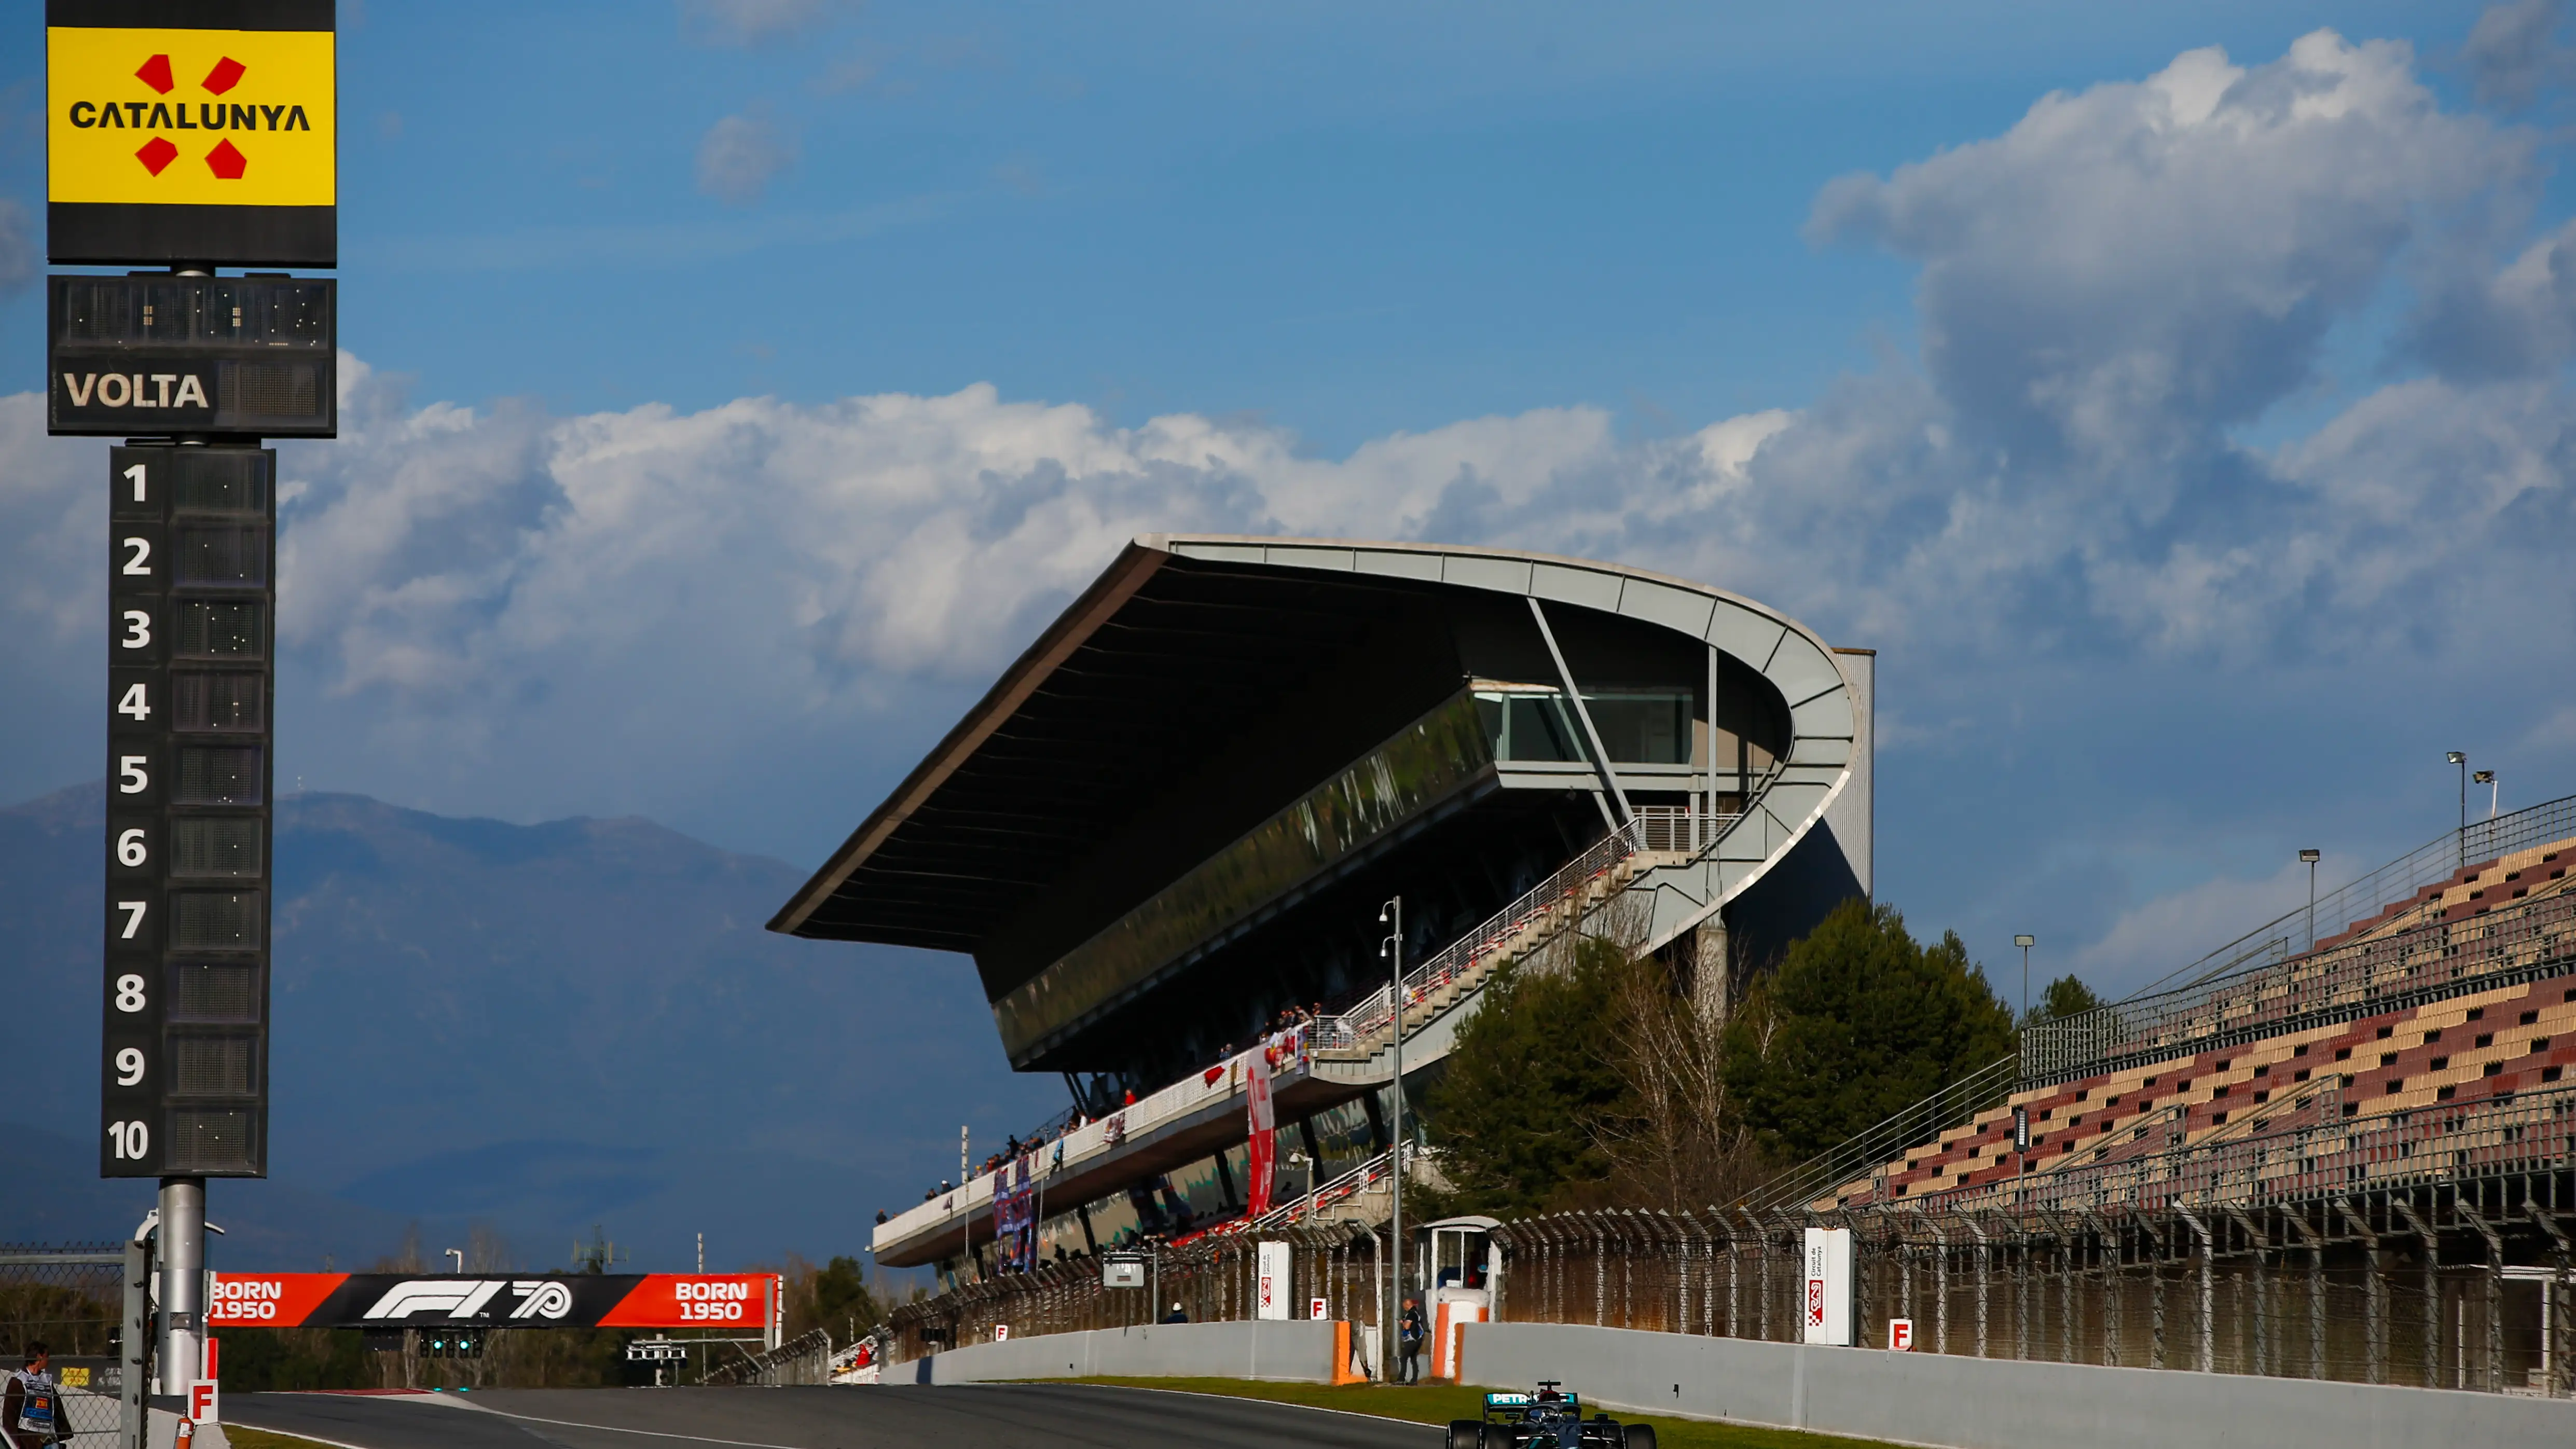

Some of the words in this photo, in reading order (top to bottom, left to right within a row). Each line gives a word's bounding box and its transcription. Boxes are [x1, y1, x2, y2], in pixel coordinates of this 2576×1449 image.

[70, 101, 310, 131] CATALUNYA
[63, 373, 209, 408] VOLTA
[123, 464, 145, 502] 1
[123, 537, 151, 575] 2
[122, 611, 150, 648] 3
[118, 683, 150, 721] 4
[120, 756, 148, 794] 5
[117, 829, 146, 867] 6
[118, 901, 146, 939] 7
[116, 974, 146, 1012] 8
[116, 1047, 145, 1086] 9
[108, 1121, 148, 1160] 10
[213, 1281, 282, 1300] BORN
[675, 1282, 748, 1300] BORN
[212, 1301, 276, 1319] 1950
[680, 1302, 742, 1320] 1950
[1313, 1301, 1323, 1317] F
[998, 1328, 1005, 1339] F
[1894, 1324, 1908, 1347] F
[192, 1385, 214, 1419] F
